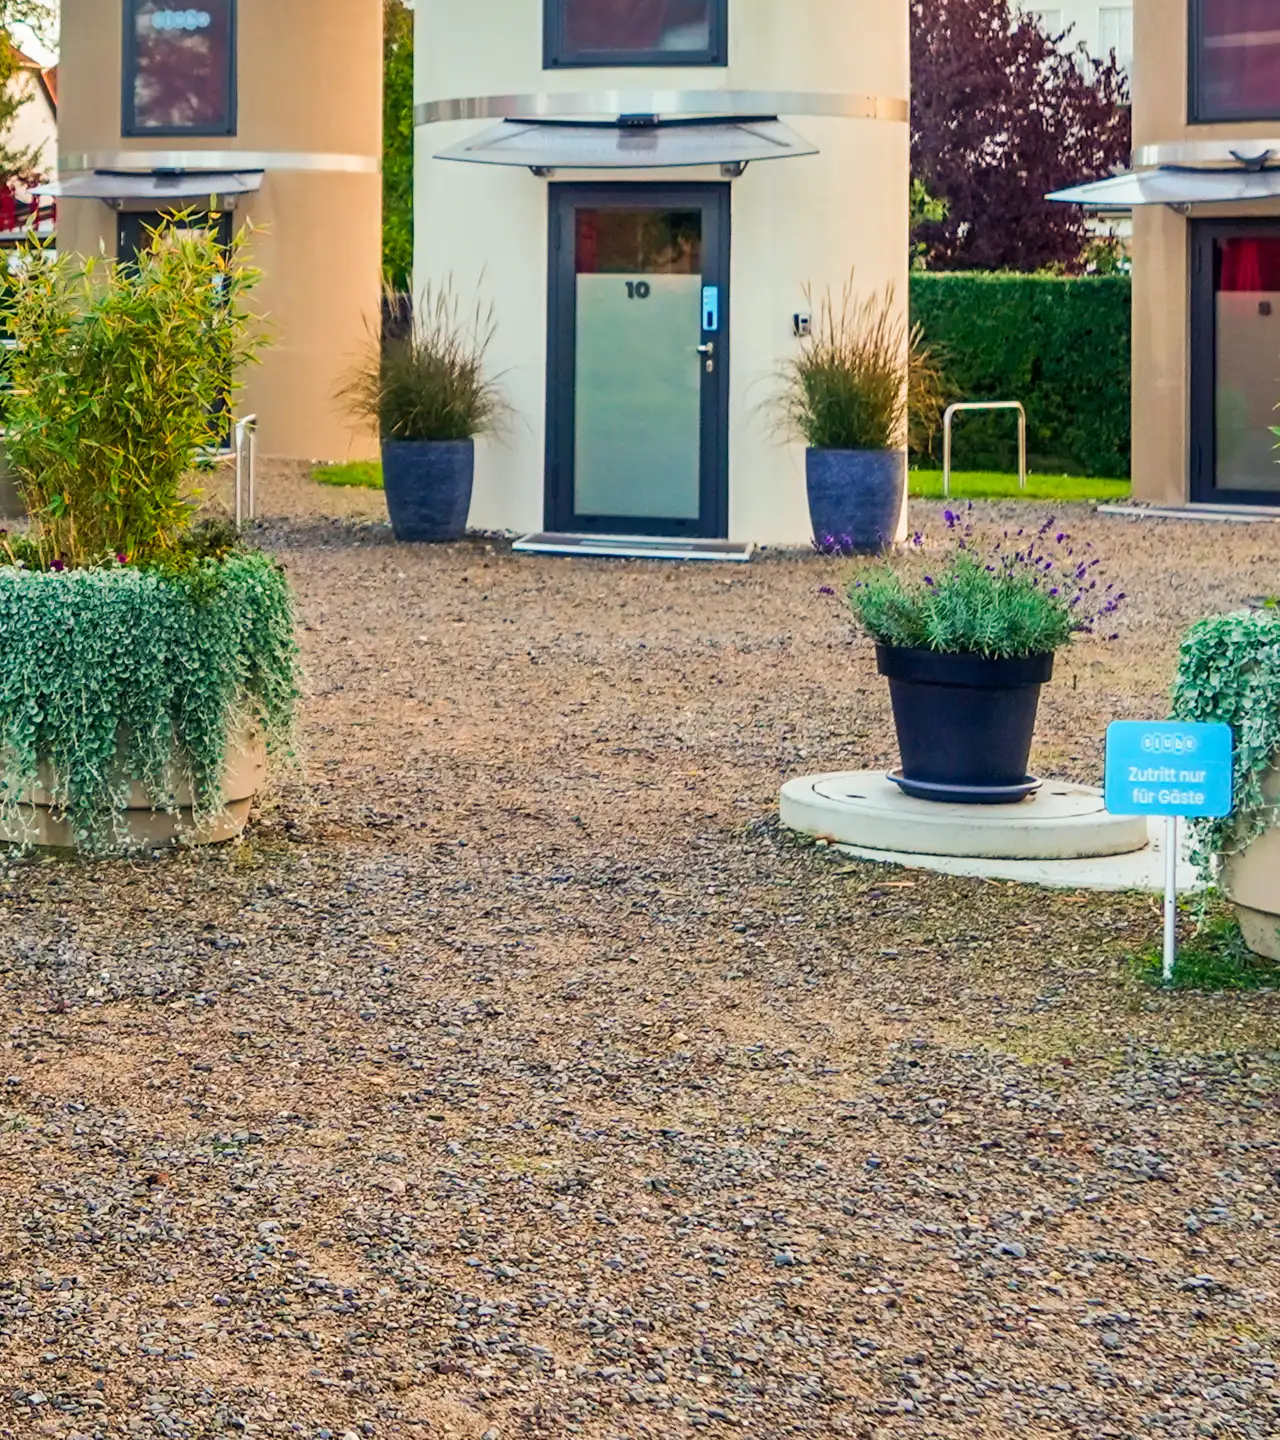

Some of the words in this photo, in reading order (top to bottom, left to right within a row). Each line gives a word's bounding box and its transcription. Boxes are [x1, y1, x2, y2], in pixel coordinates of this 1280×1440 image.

[625, 281, 650, 299] 10
[1128, 766, 1176, 782] Zutritt
[1180, 770, 1206, 783] nur
[1132, 788, 1155, 804] für
[1158, 789, 1205, 805] Gäste
